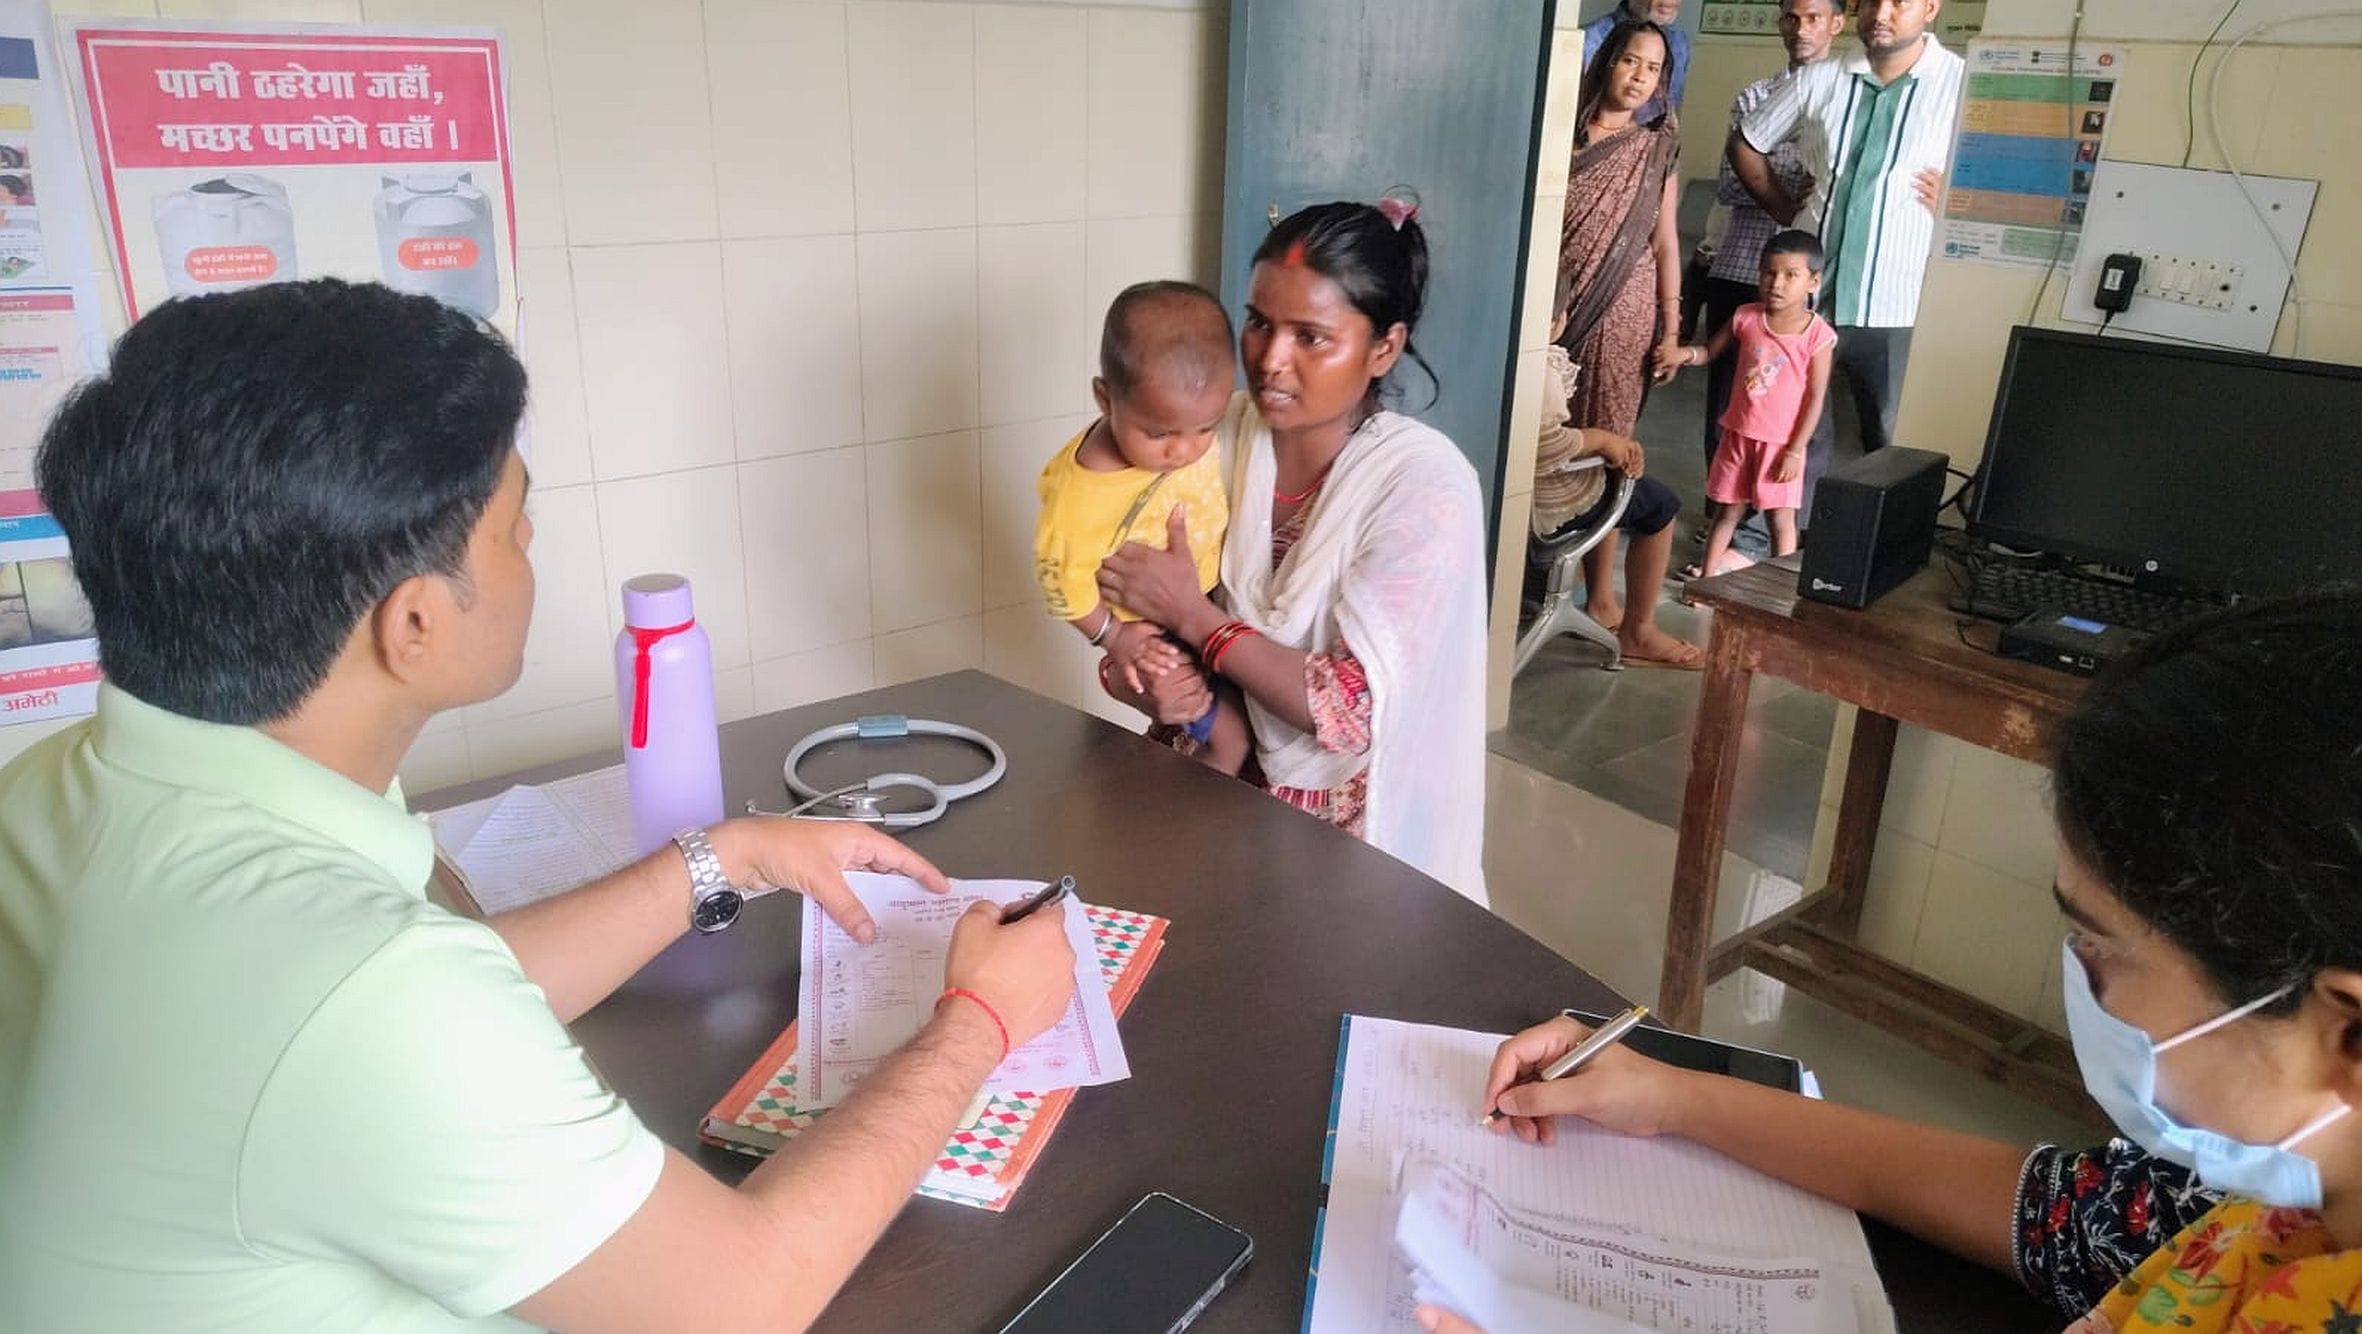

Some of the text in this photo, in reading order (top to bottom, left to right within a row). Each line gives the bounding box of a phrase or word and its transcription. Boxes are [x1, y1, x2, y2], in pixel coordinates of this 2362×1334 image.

[154, 62, 444, 105] पानी ठहरेगा जहाँ,
[157, 124, 254, 152] मच्छर
[260, 114, 368, 151] पनपेंगे
[376, 115, 435, 150] वहाँ
